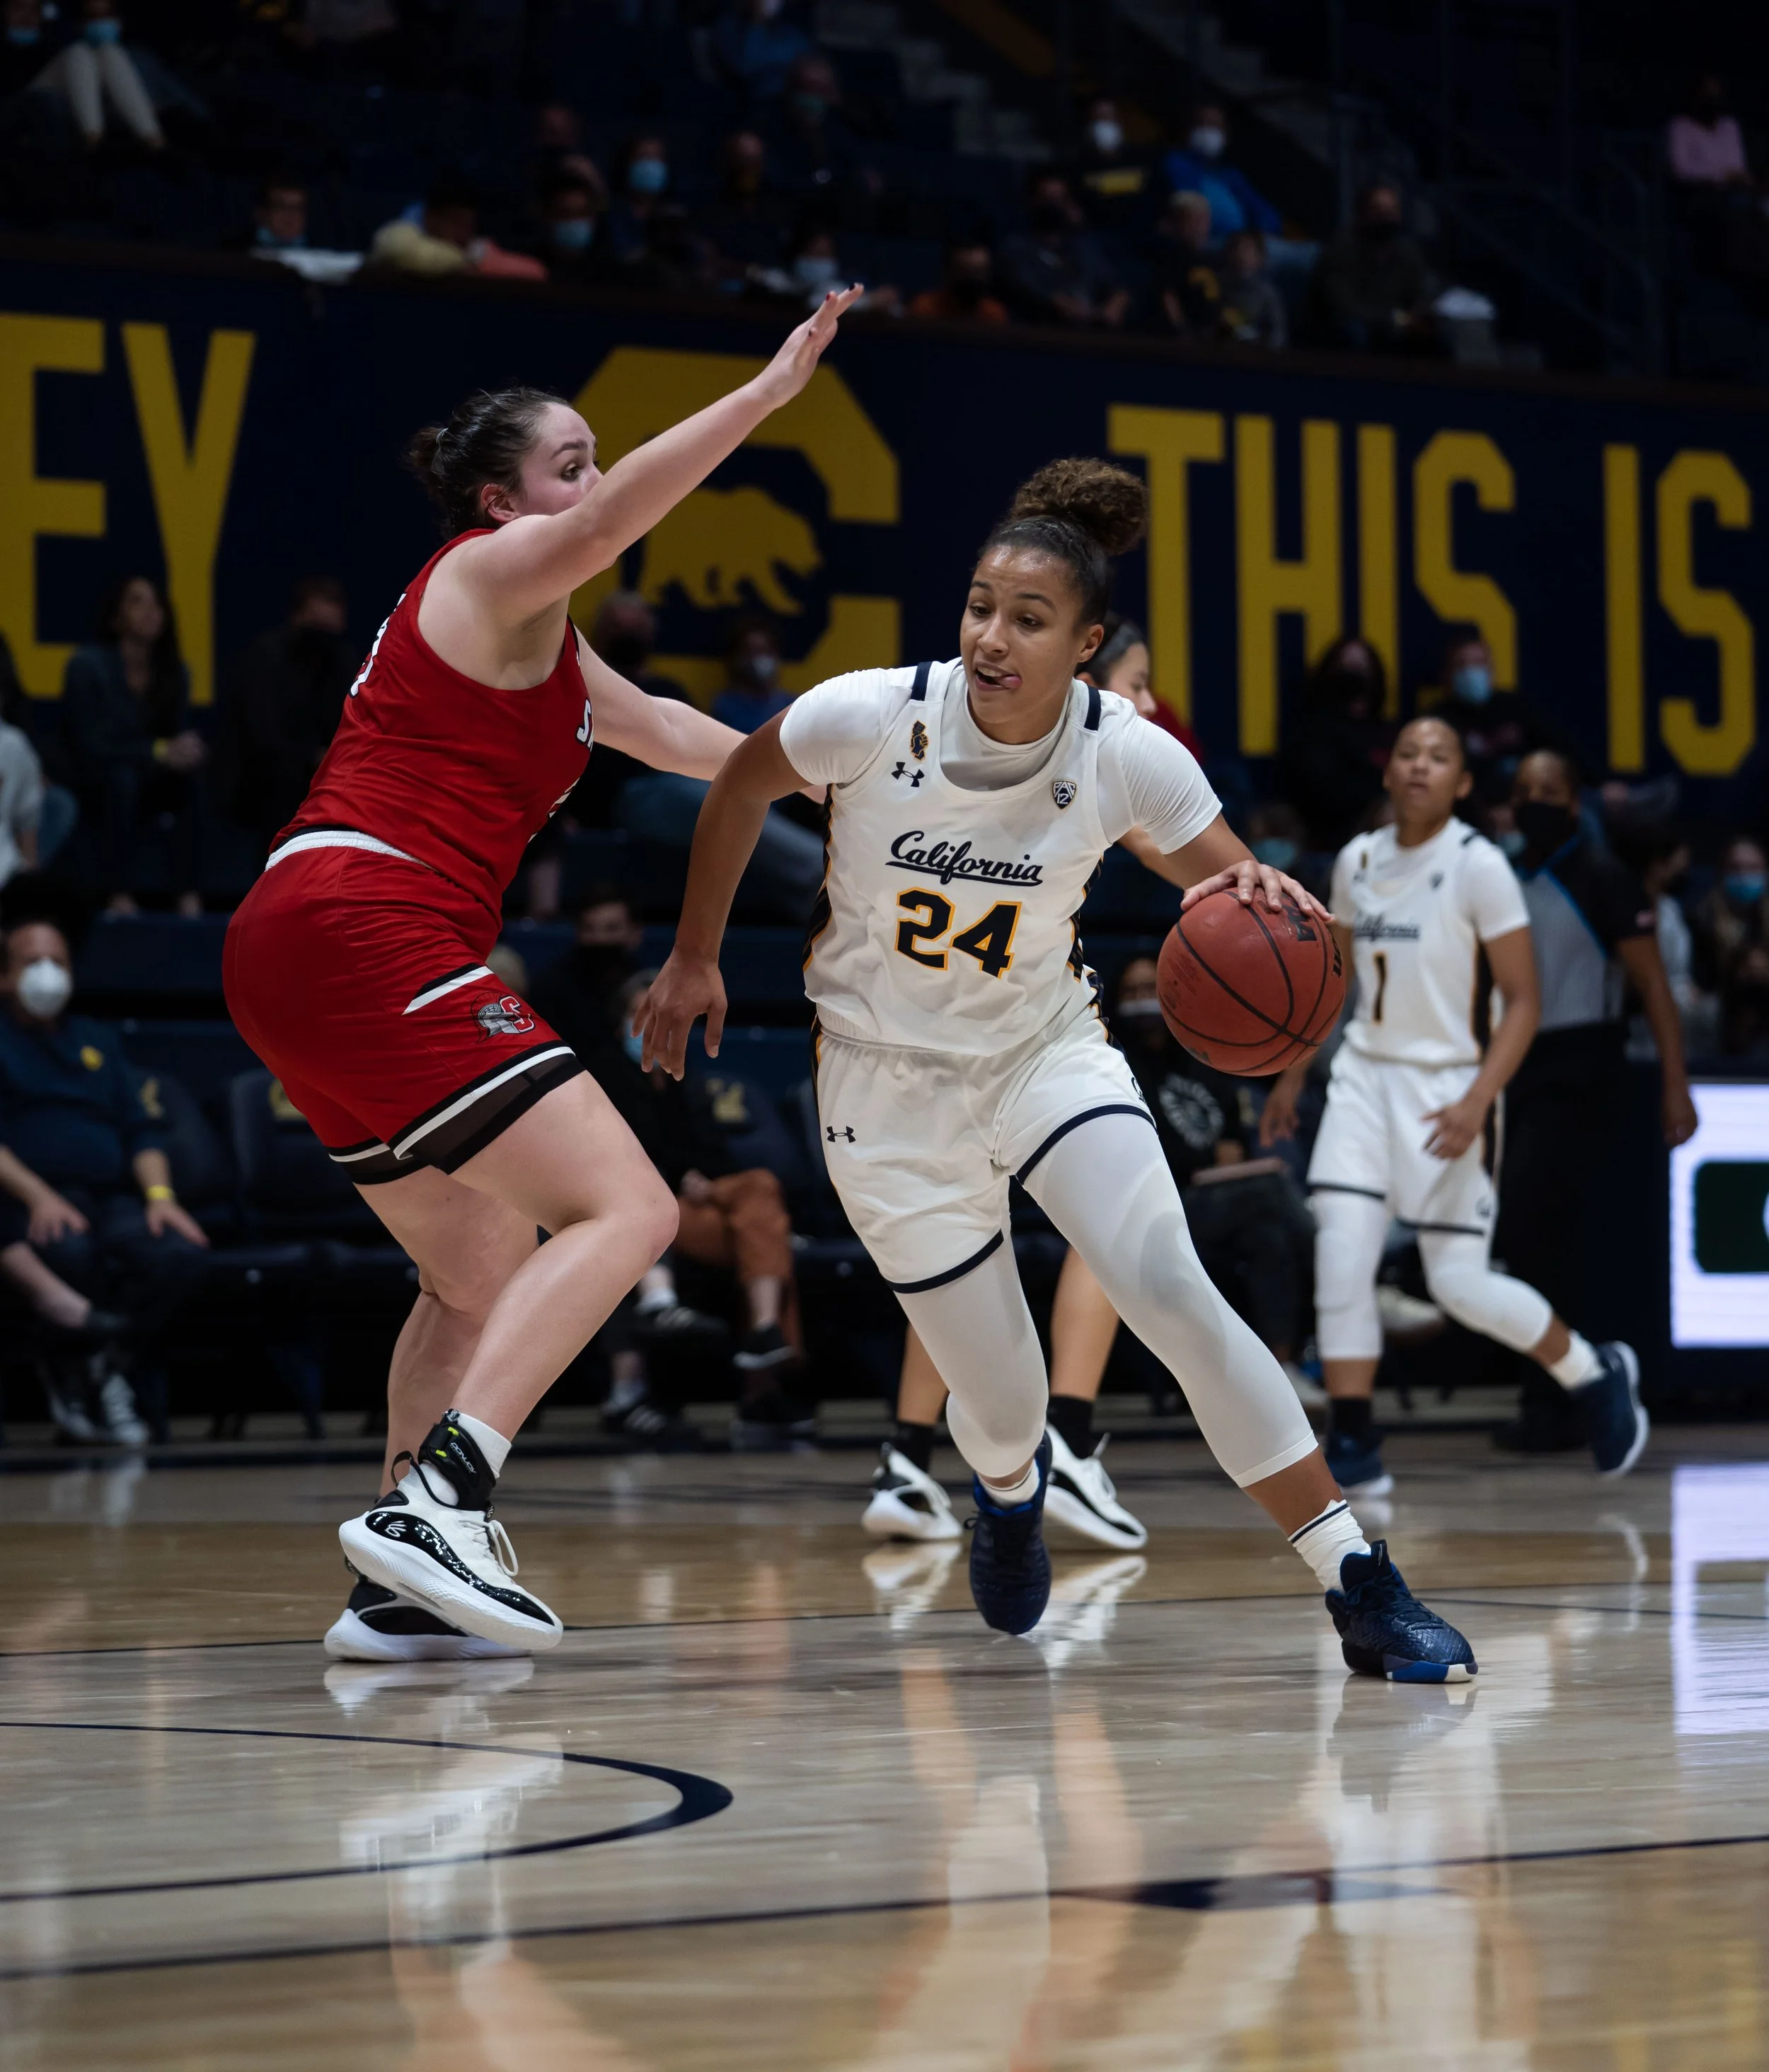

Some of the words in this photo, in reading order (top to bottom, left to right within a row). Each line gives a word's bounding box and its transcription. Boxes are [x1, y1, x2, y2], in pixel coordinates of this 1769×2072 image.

[1107, 403, 1519, 757] THIS
[1603, 443, 1756, 776] IS
[1053, 781, 1076, 799] PAC
[1056, 793, 1069, 805] 12
[884, 830, 1044, 887] California
[894, 886, 1022, 980] 24
[1371, 950, 1388, 1025] 1
